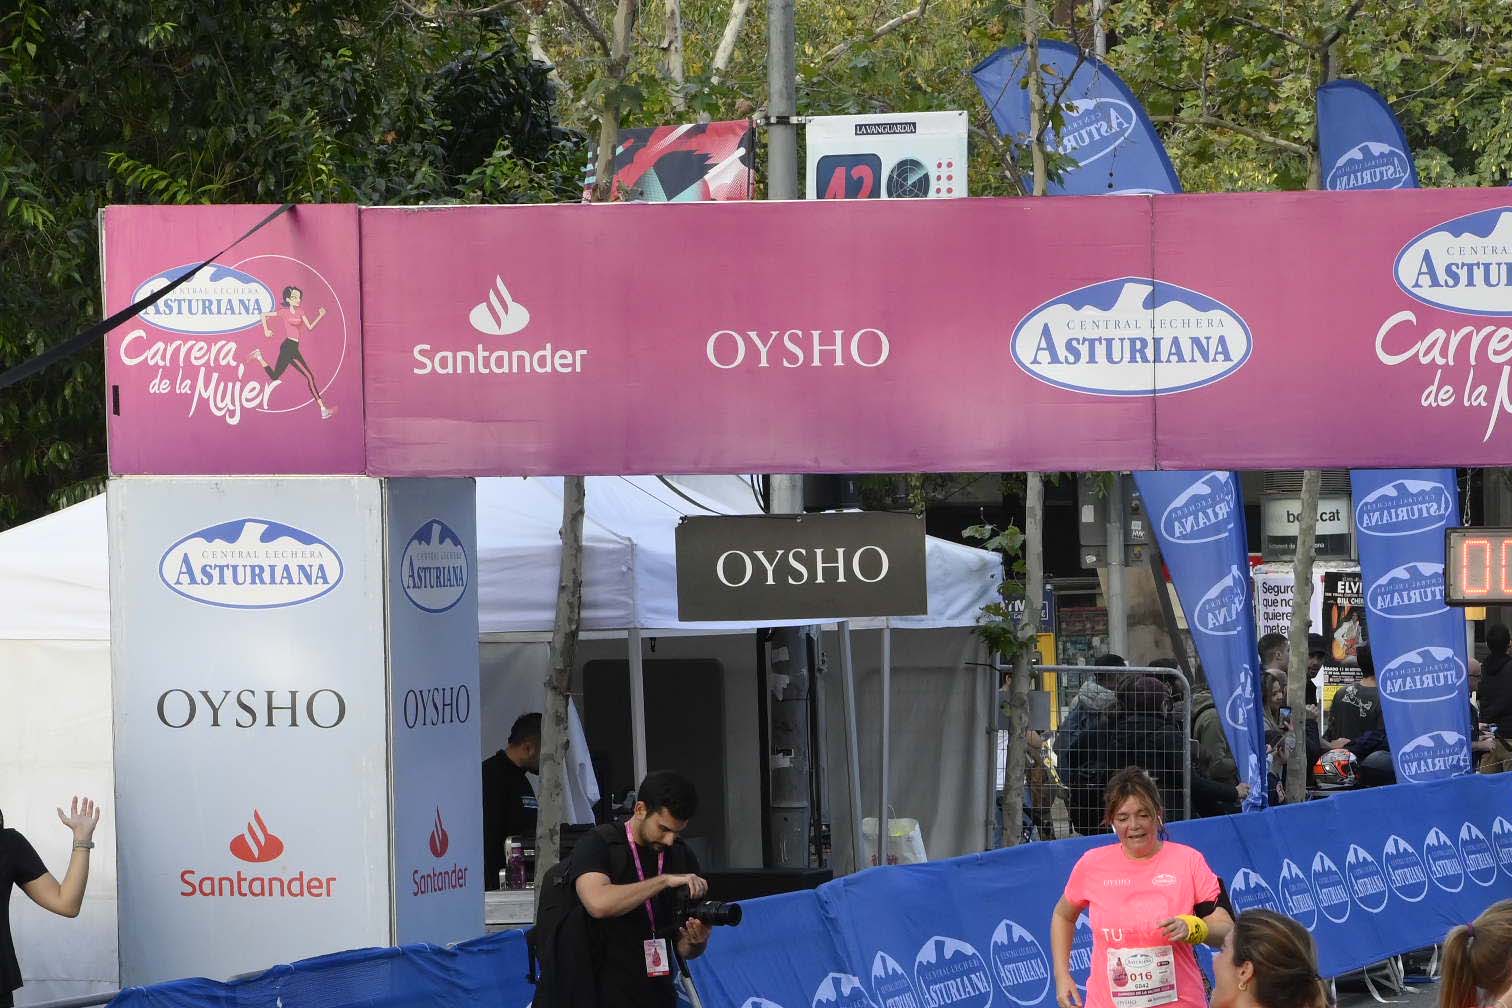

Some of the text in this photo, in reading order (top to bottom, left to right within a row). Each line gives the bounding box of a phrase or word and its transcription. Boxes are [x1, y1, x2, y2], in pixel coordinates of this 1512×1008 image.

[857, 122, 916, 135] LA VANGUARDIA
[142, 289, 263, 318] ASTURIANA
[1066, 316, 1226, 332] CENTRAL LECHERA
[119, 329, 237, 369] Carrera
[413, 343, 588, 375] Santander
[706, 327, 891, 370] OYSHO
[1029, 322, 1234, 367] ASTURIANA
[149, 363, 282, 426] de la Mujer
[1420, 368, 1456, 408] de
[1463, 368, 1488, 408] la
[174, 552, 331, 588] ASTURIANA
[202, 549, 325, 561] CENTRAL LECHERA
[716, 545, 889, 587] OYSHO
[406, 555, 465, 592] ASTURIANA
[1337, 581, 1363, 594] ELVI
[1262, 598, 1279, 610] que
[156, 688, 347, 730] OYSHO
[403, 684, 470, 729] OYSHO
[180, 868, 337, 898] Santander
[411, 863, 469, 897] Santander
[1101, 928, 1123, 942] TU
[996, 953, 1047, 987] ASTURIANA
[1130, 971, 1153, 982] 016
